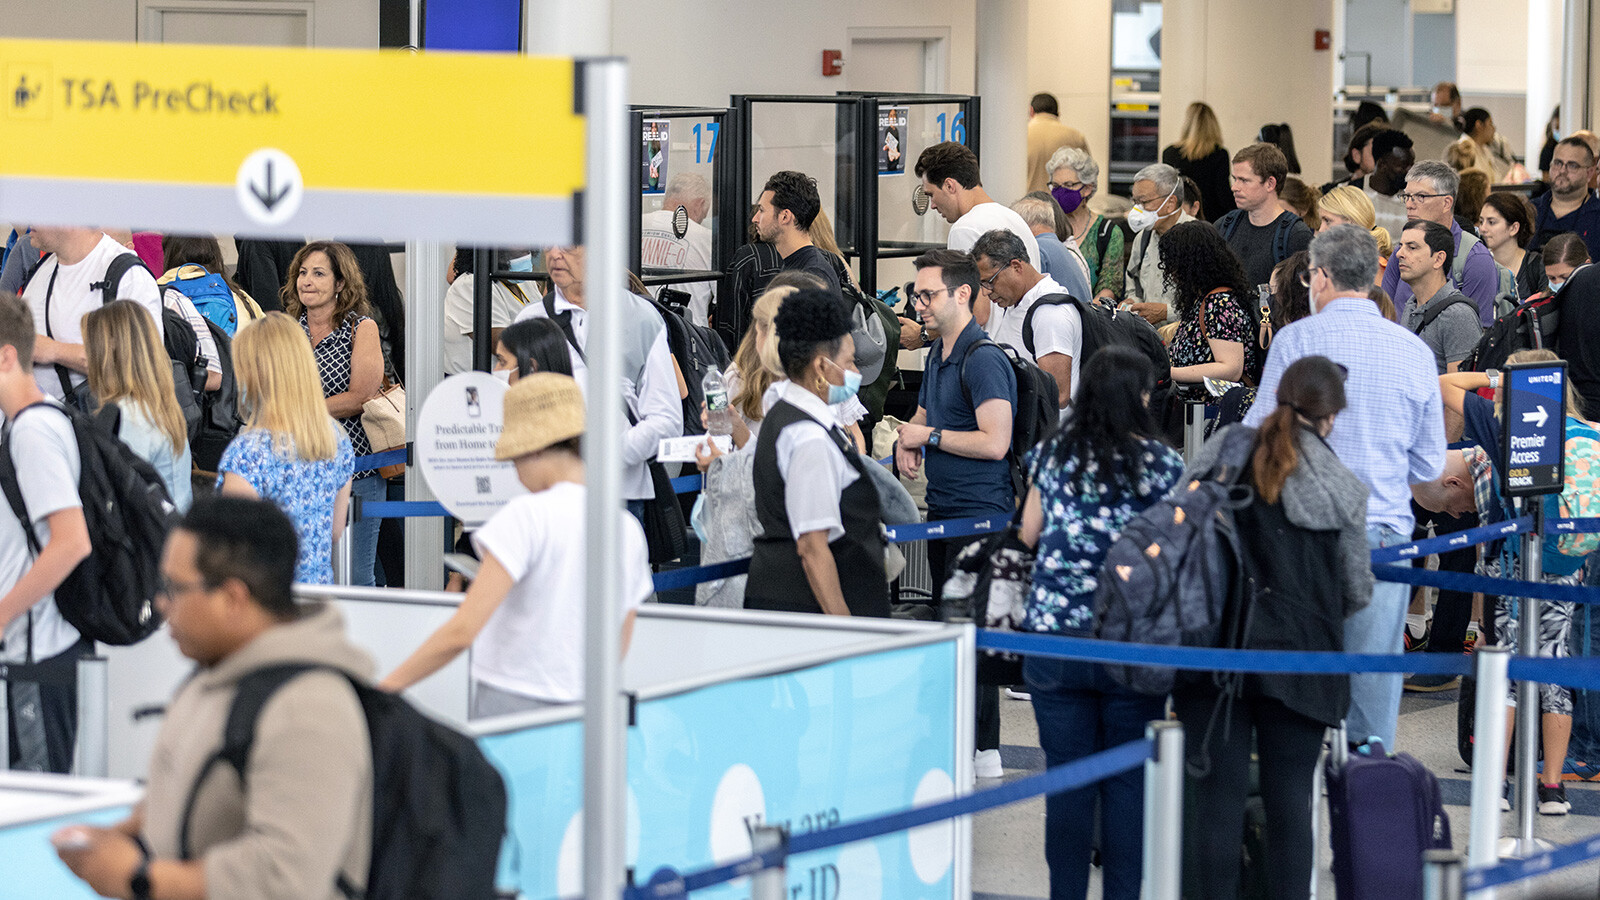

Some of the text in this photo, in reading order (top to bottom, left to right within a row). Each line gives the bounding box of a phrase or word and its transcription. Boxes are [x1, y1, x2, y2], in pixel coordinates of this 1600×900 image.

[62, 78, 280, 115] TSA PreCheck
[936, 111, 966, 146] 16
[692, 122, 720, 164] 17
[1528, 375, 1554, 385] UNITED
[435, 423, 505, 435] Predictable Tra
[435, 439, 457, 450] from
[459, 440, 487, 450] Home
[1510, 433, 1546, 449] Premier
[1509, 450, 1540, 464] Access
[1508, 468, 1530, 477] GOLD
[1508, 476, 1533, 486] TRACK
[801, 807, 840, 834] are
[809, 863, 840, 900] ID
